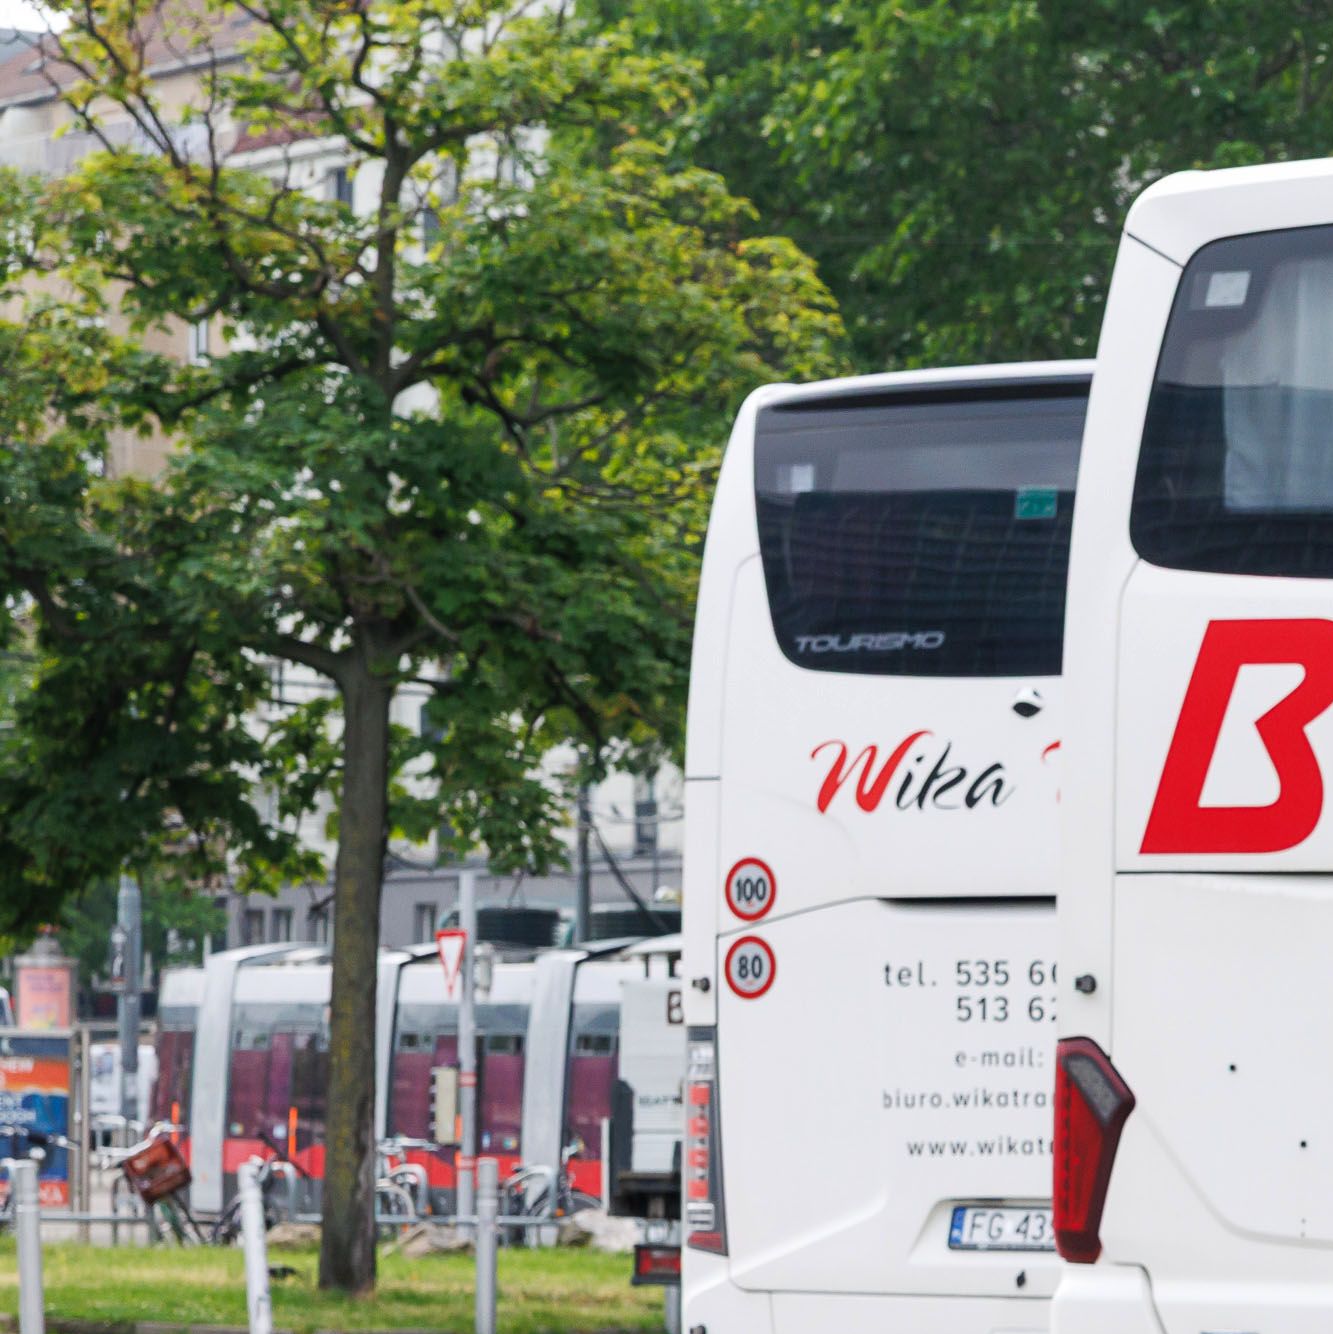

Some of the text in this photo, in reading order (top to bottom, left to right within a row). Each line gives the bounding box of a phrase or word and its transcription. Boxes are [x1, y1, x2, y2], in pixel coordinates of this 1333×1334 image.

[795, 631, 945, 653] TOURISMO
[811, 730, 1015, 815] Wika
[736, 878, 767, 901] 100
[738, 955, 763, 979] 80
[883, 960, 1056, 986] tel. 535 6
[956, 996, 1009, 1022] 513
[955, 1047, 1044, 1067] e-mail:
[882, 1088, 1054, 1109] biuro.wikatra
[970, 1212, 1054, 1240] FG 43
